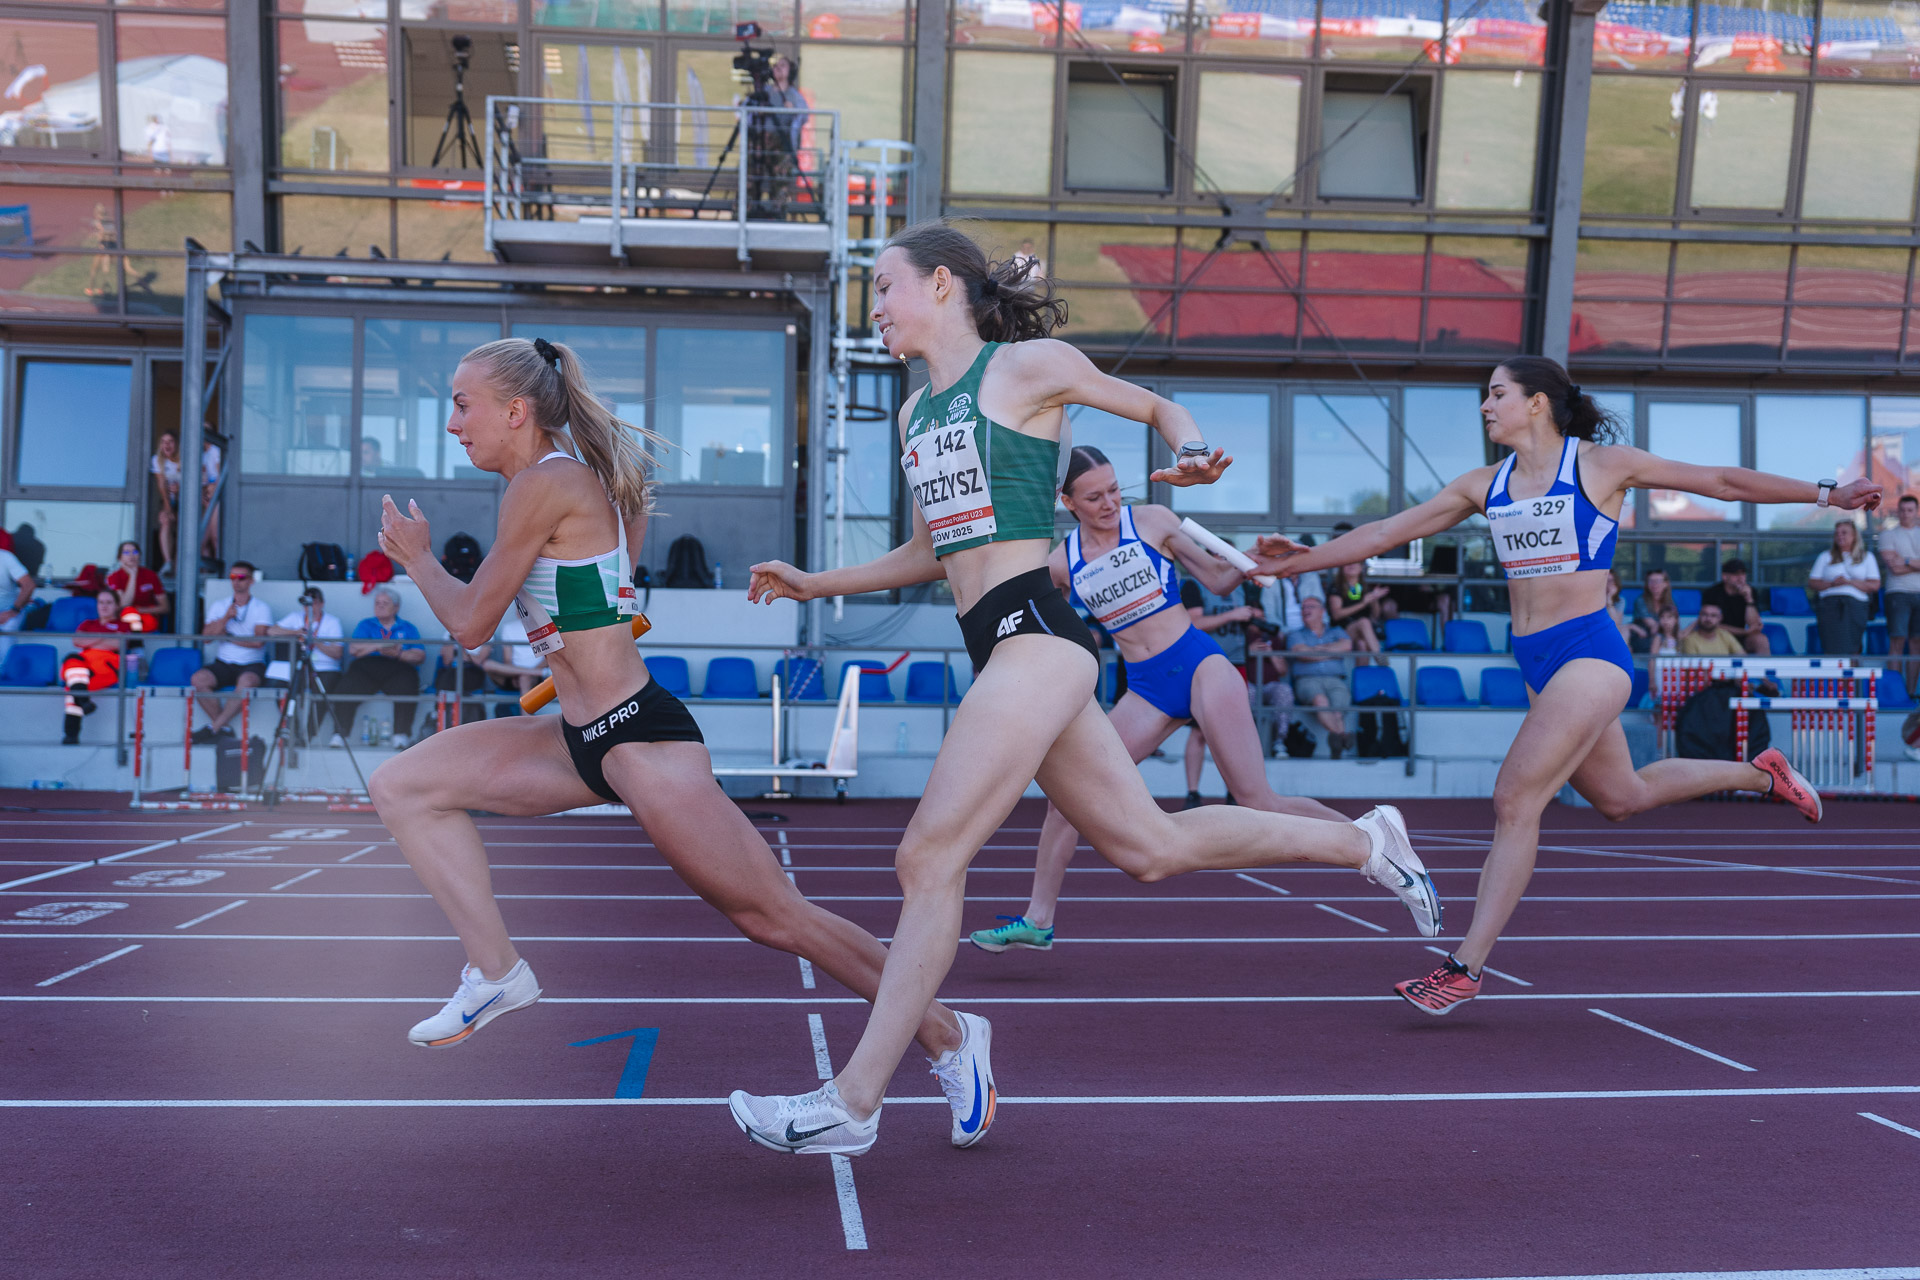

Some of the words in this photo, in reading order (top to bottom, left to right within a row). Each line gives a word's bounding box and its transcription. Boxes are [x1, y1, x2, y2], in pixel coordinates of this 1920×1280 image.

[934, 429, 966, 457] 142
[970, 509, 984, 519] U23
[1497, 509, 1523, 518] Kraków
[1532, 500, 1565, 517] 329
[951, 525, 973, 538] 2025
[1503, 528, 1562, 551] TKOCZ
[1110, 547, 1138, 568] 324
[1513, 566, 1541, 576] KRAKÓW
[1542, 565, 1562, 573] 2025
[1084, 566, 1156, 611] MACIEJCZEK
[1112, 611, 1138, 626] KRAKÓW
[1138, 602, 1155, 614] 2025
[582, 720, 608, 742] NIKE
[609, 701, 639, 729] PRO
[1770, 762, 1793, 789] balance
[1792, 786, 1805, 800] new
